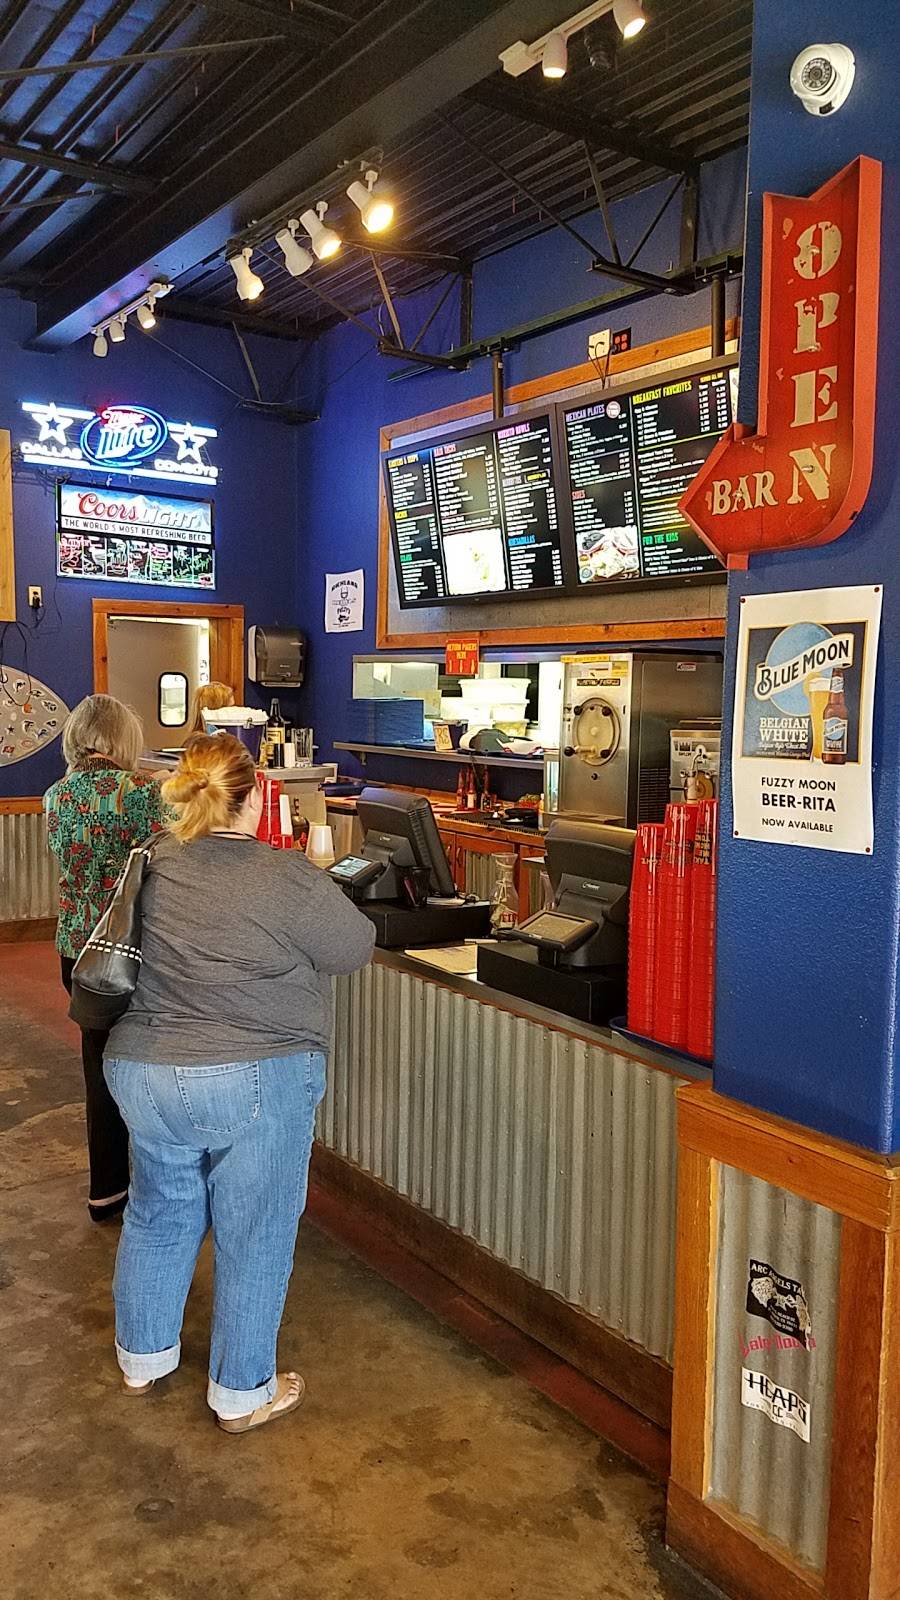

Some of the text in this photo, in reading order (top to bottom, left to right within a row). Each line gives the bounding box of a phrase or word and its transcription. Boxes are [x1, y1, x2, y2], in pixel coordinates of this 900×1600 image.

[790, 221, 842, 501] OPEN
[632, 380, 692, 405] BREAKFAST FAVORITES
[587, 404, 605, 417] PLATES
[711, 469, 778, 516] BAR
[78, 492, 198, 529] Coors LIGHT
[64, 519, 81, 528] THE
[119, 523, 139, 534] MOST
[141, 526, 186, 540] REFRESHING
[188, 531, 207, 542] BEER
[757, 639, 849, 695] BLUE MOON
[759, 717, 810, 728] BELGIAN
[759, 728, 809, 742] WHITE
[761, 777, 836, 791] FUZZY MOON
[761, 793, 836, 813] BEER-RITA
[761, 818, 834, 833] NOW AVAILABLE
[751, 1263, 768, 1274] ARC
[744, 1372, 806, 1425] HEAPS
